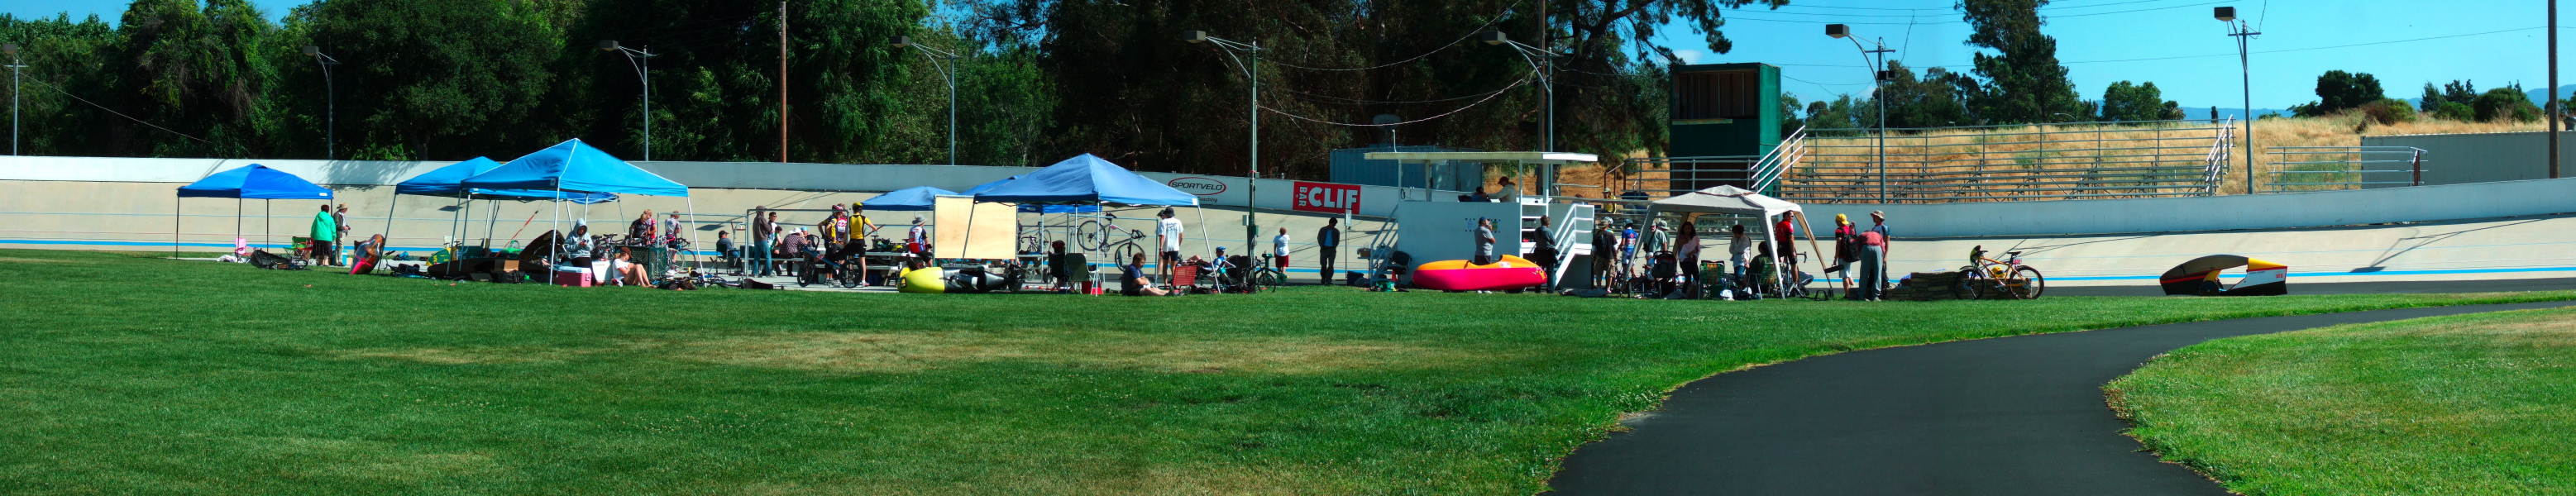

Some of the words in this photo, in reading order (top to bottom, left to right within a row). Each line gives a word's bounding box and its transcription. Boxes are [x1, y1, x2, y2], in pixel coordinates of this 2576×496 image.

[1171, 182, 1223, 191] SPORTVELO
[1298, 186, 1307, 207] BAR
[1308, 186, 1359, 209] CLIF
